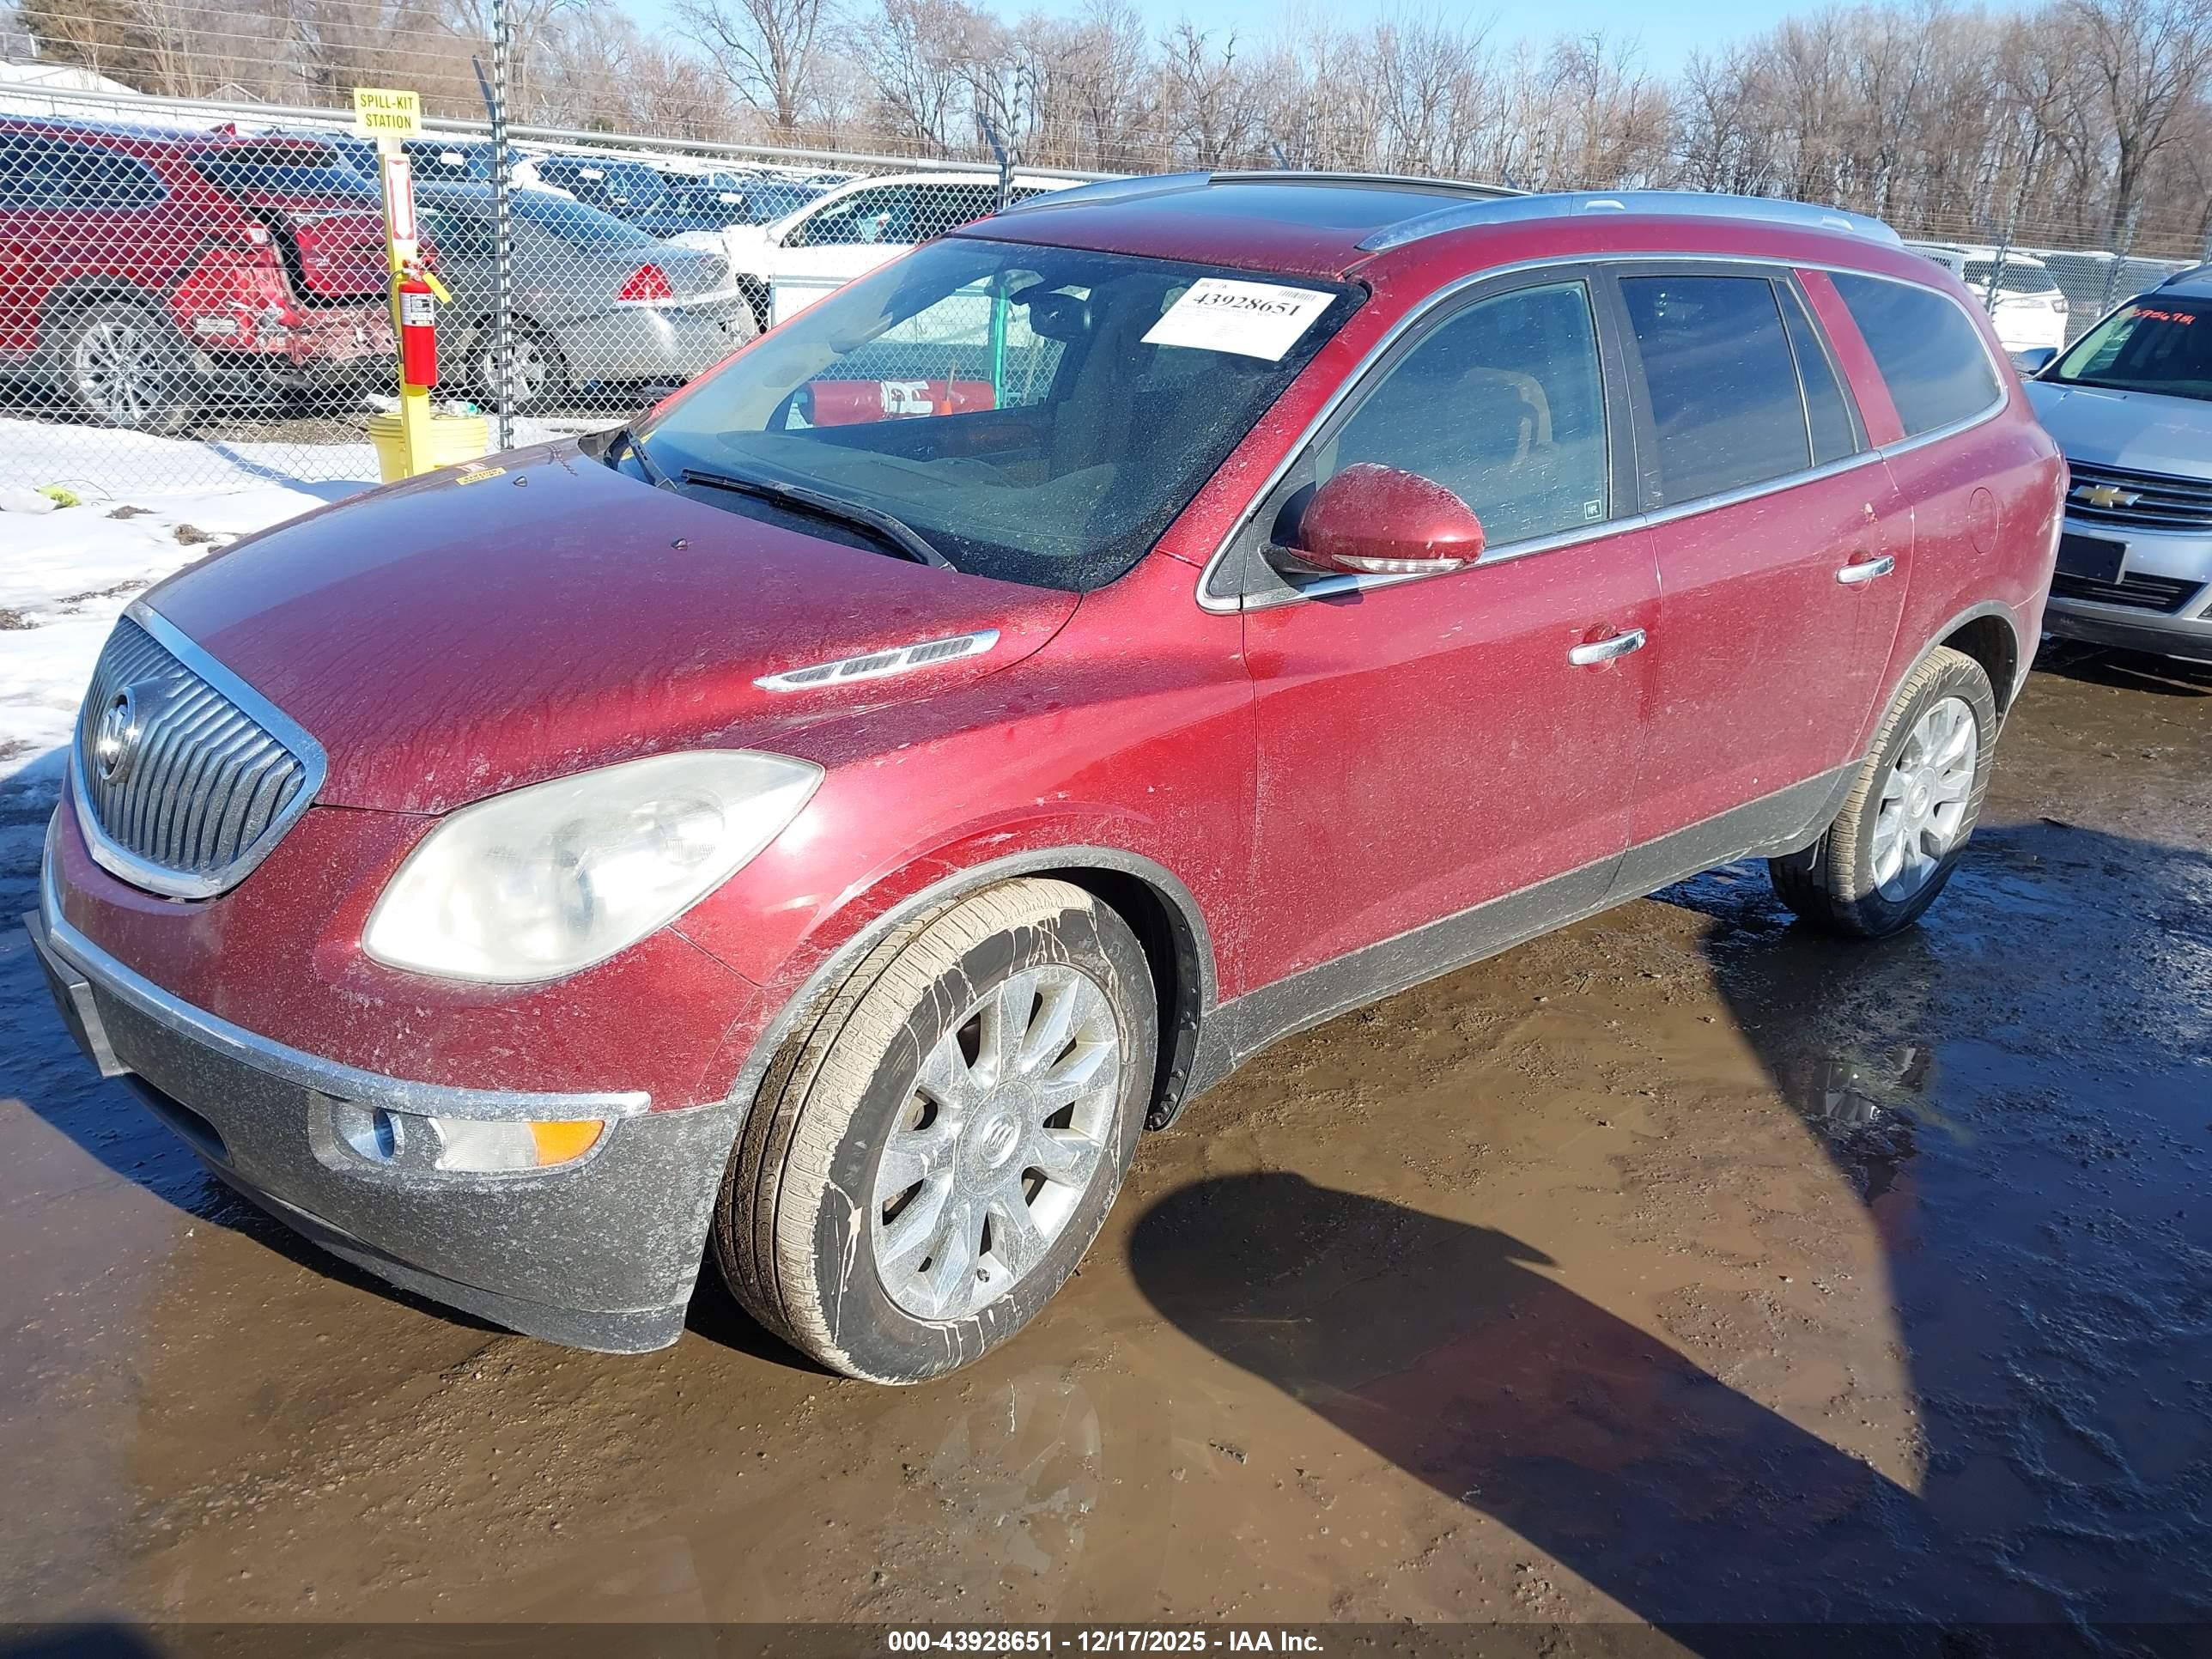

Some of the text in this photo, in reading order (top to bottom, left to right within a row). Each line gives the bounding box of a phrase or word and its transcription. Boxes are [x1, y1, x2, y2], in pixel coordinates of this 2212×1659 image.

[361, 94, 413, 110] SPILL-KIT
[366, 114, 411, 129] STATION
[1193, 293, 1302, 316] 43928651
